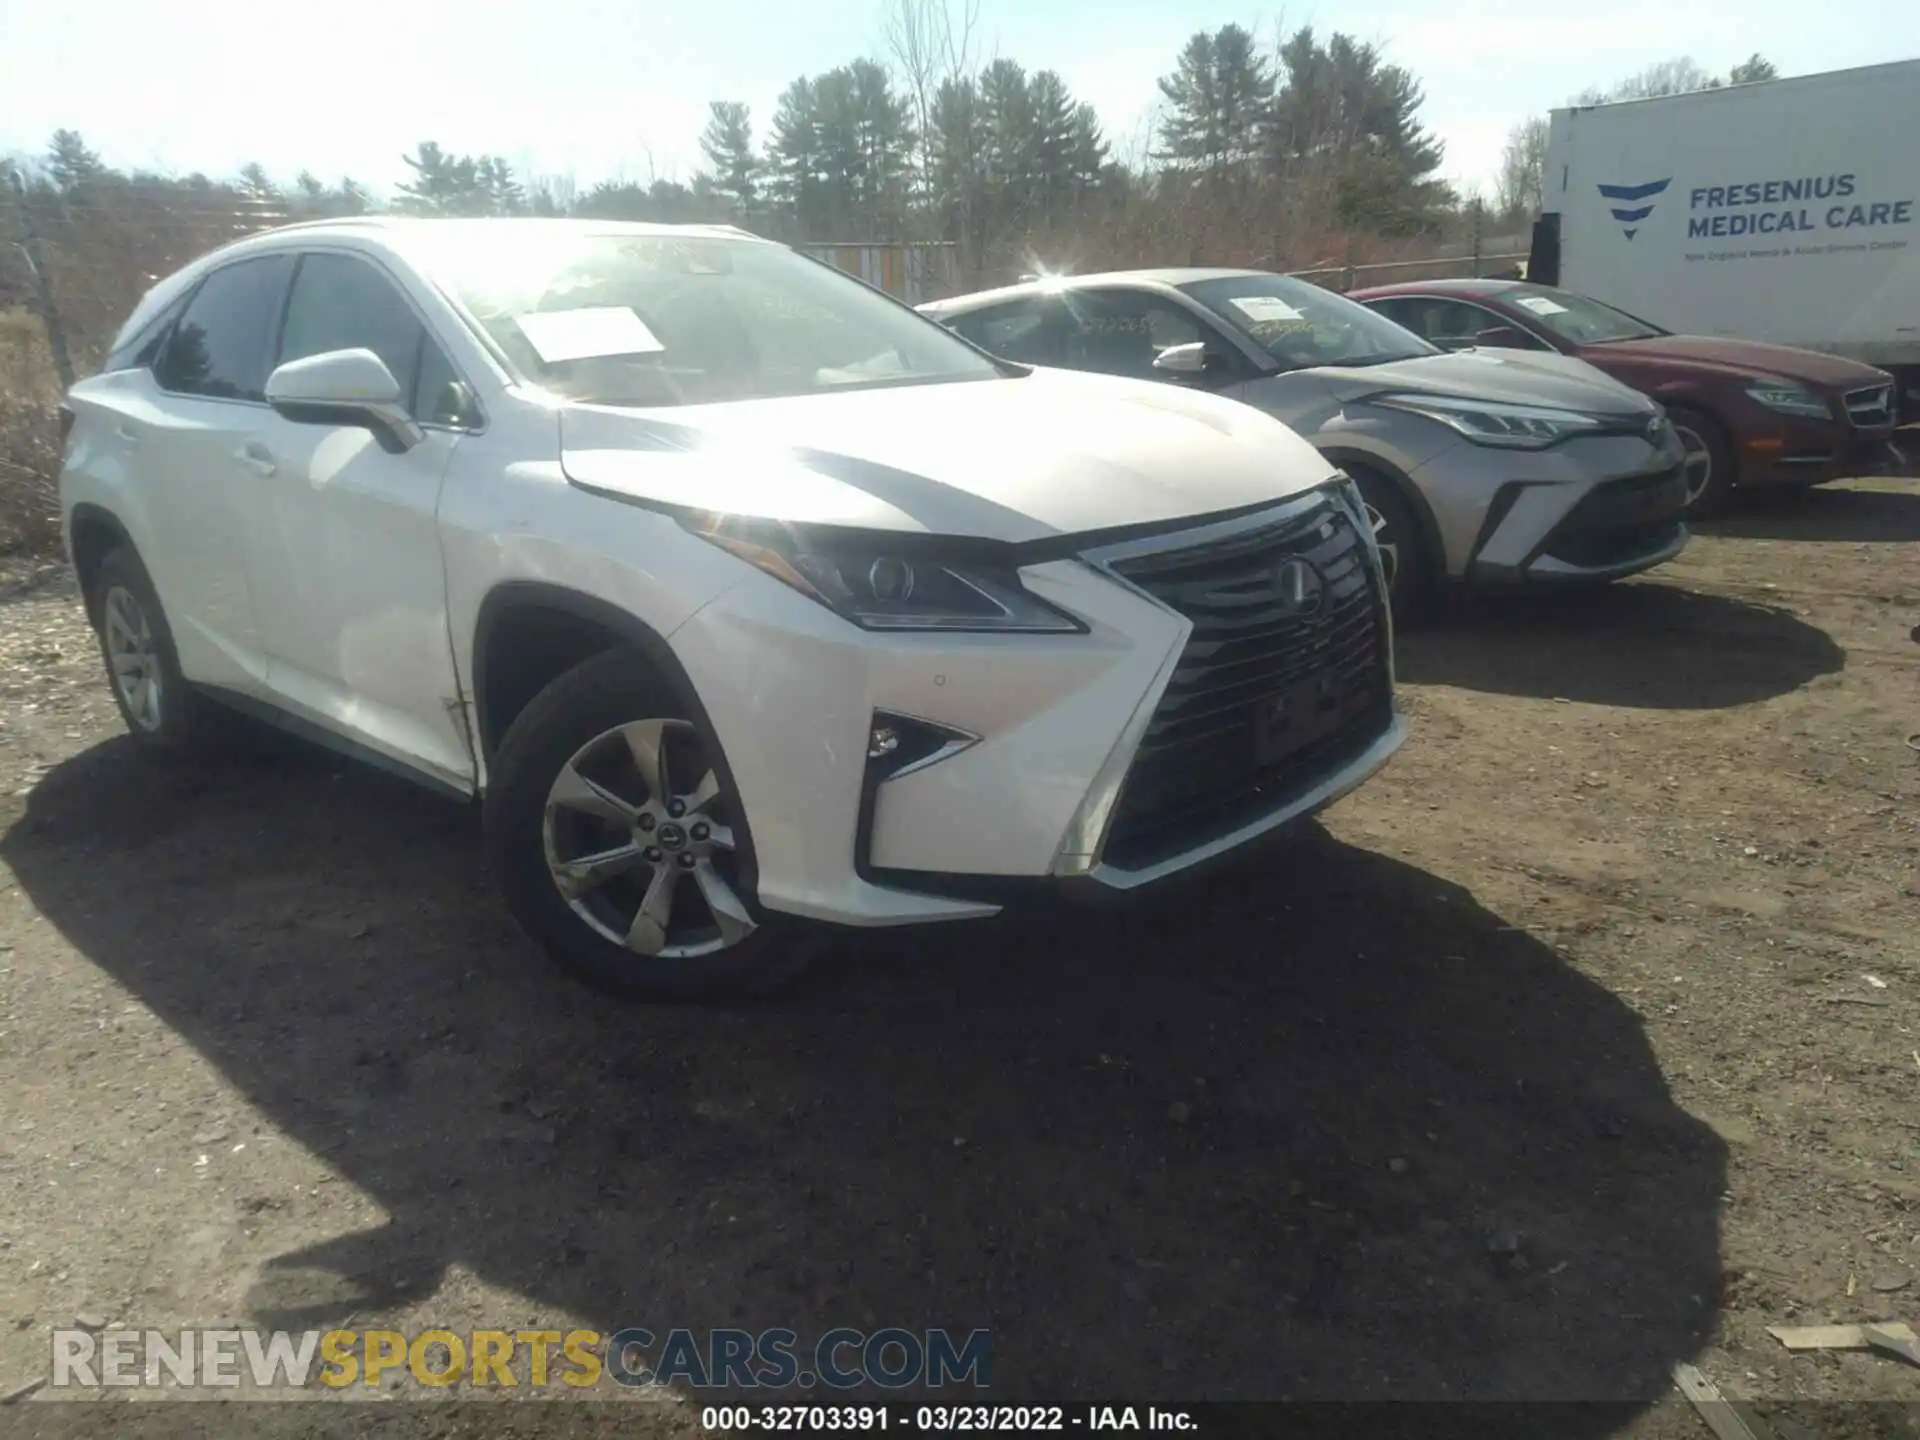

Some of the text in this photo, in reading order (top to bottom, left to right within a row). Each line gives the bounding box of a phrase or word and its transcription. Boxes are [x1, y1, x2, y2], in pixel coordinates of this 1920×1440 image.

[1691, 174, 1855, 208] FRESENIUS
[1687, 200, 1913, 238] MEDICAL CARE
